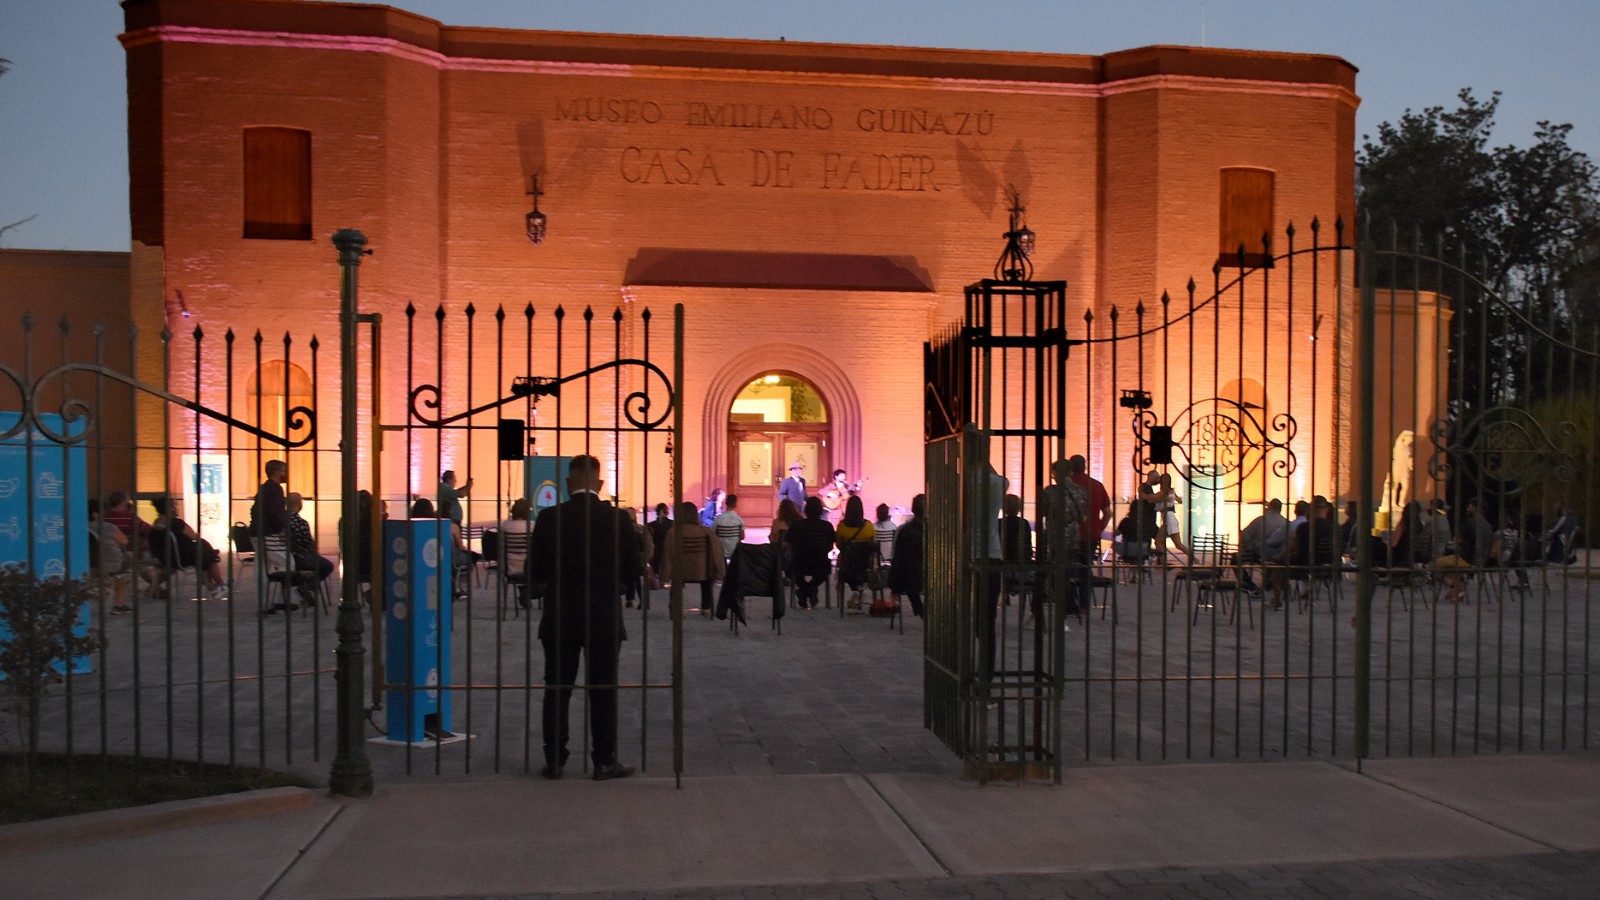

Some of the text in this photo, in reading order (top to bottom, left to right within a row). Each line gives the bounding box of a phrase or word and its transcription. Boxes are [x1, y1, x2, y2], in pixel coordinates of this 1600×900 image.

[553, 97, 663, 124] MUSEO
[685, 101, 833, 130] EMILIANO
[620, 146, 941, 192] CASA DE FADER
